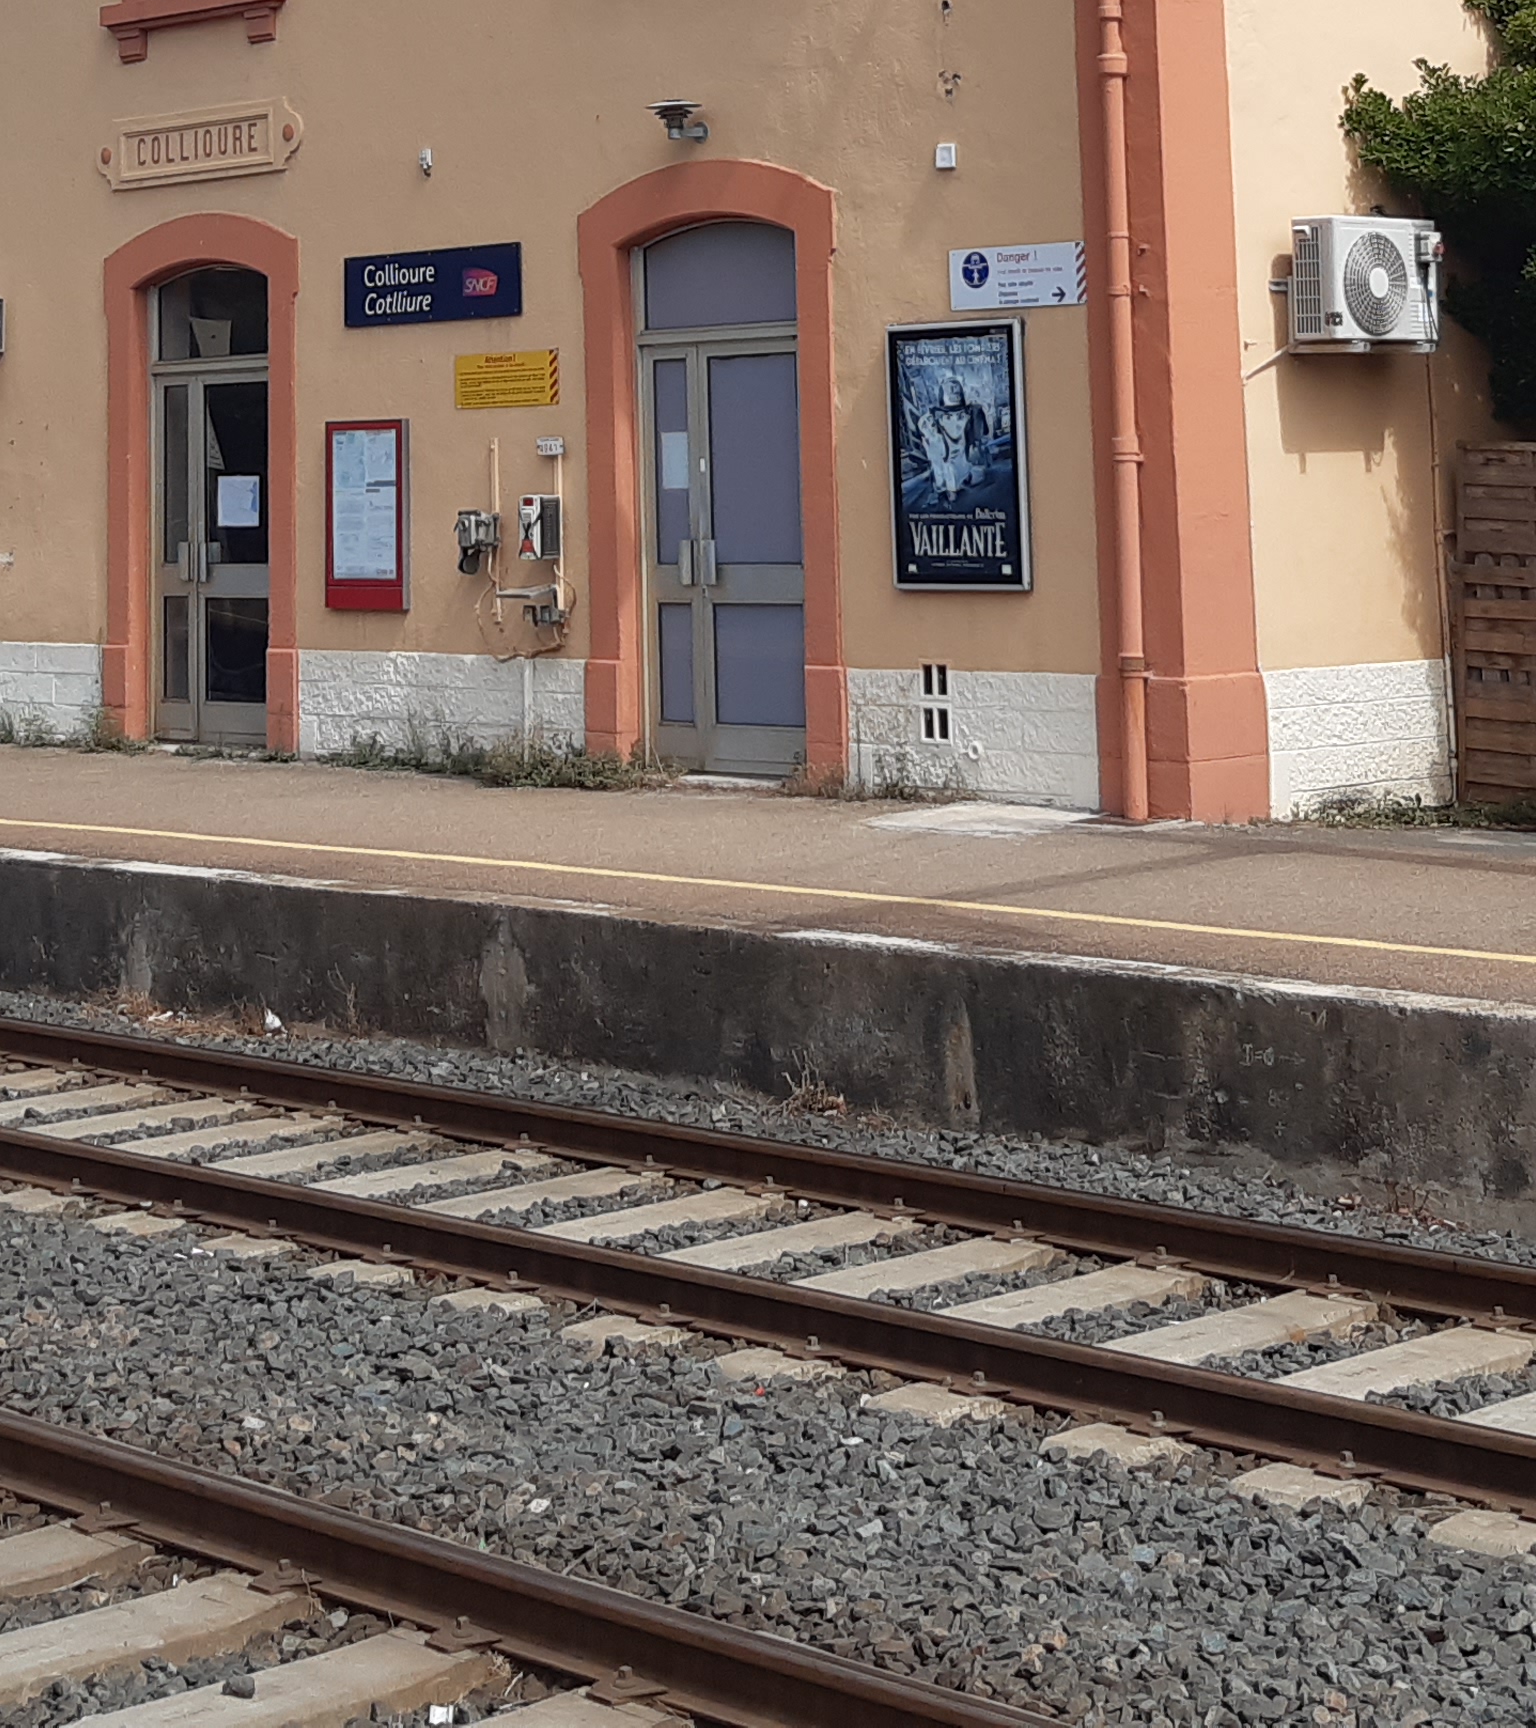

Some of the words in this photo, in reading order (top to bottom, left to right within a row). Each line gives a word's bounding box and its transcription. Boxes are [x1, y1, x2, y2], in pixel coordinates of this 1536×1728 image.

[136, 122, 258, 166] COLLIOURE
[996, 251, 1031, 264] Danger
[364, 263, 435, 287] Collioure
[464, 276, 496, 293] SNCF
[365, 290, 432, 315] Cotlliure
[908, 521, 1007, 558] VAILLANTE
